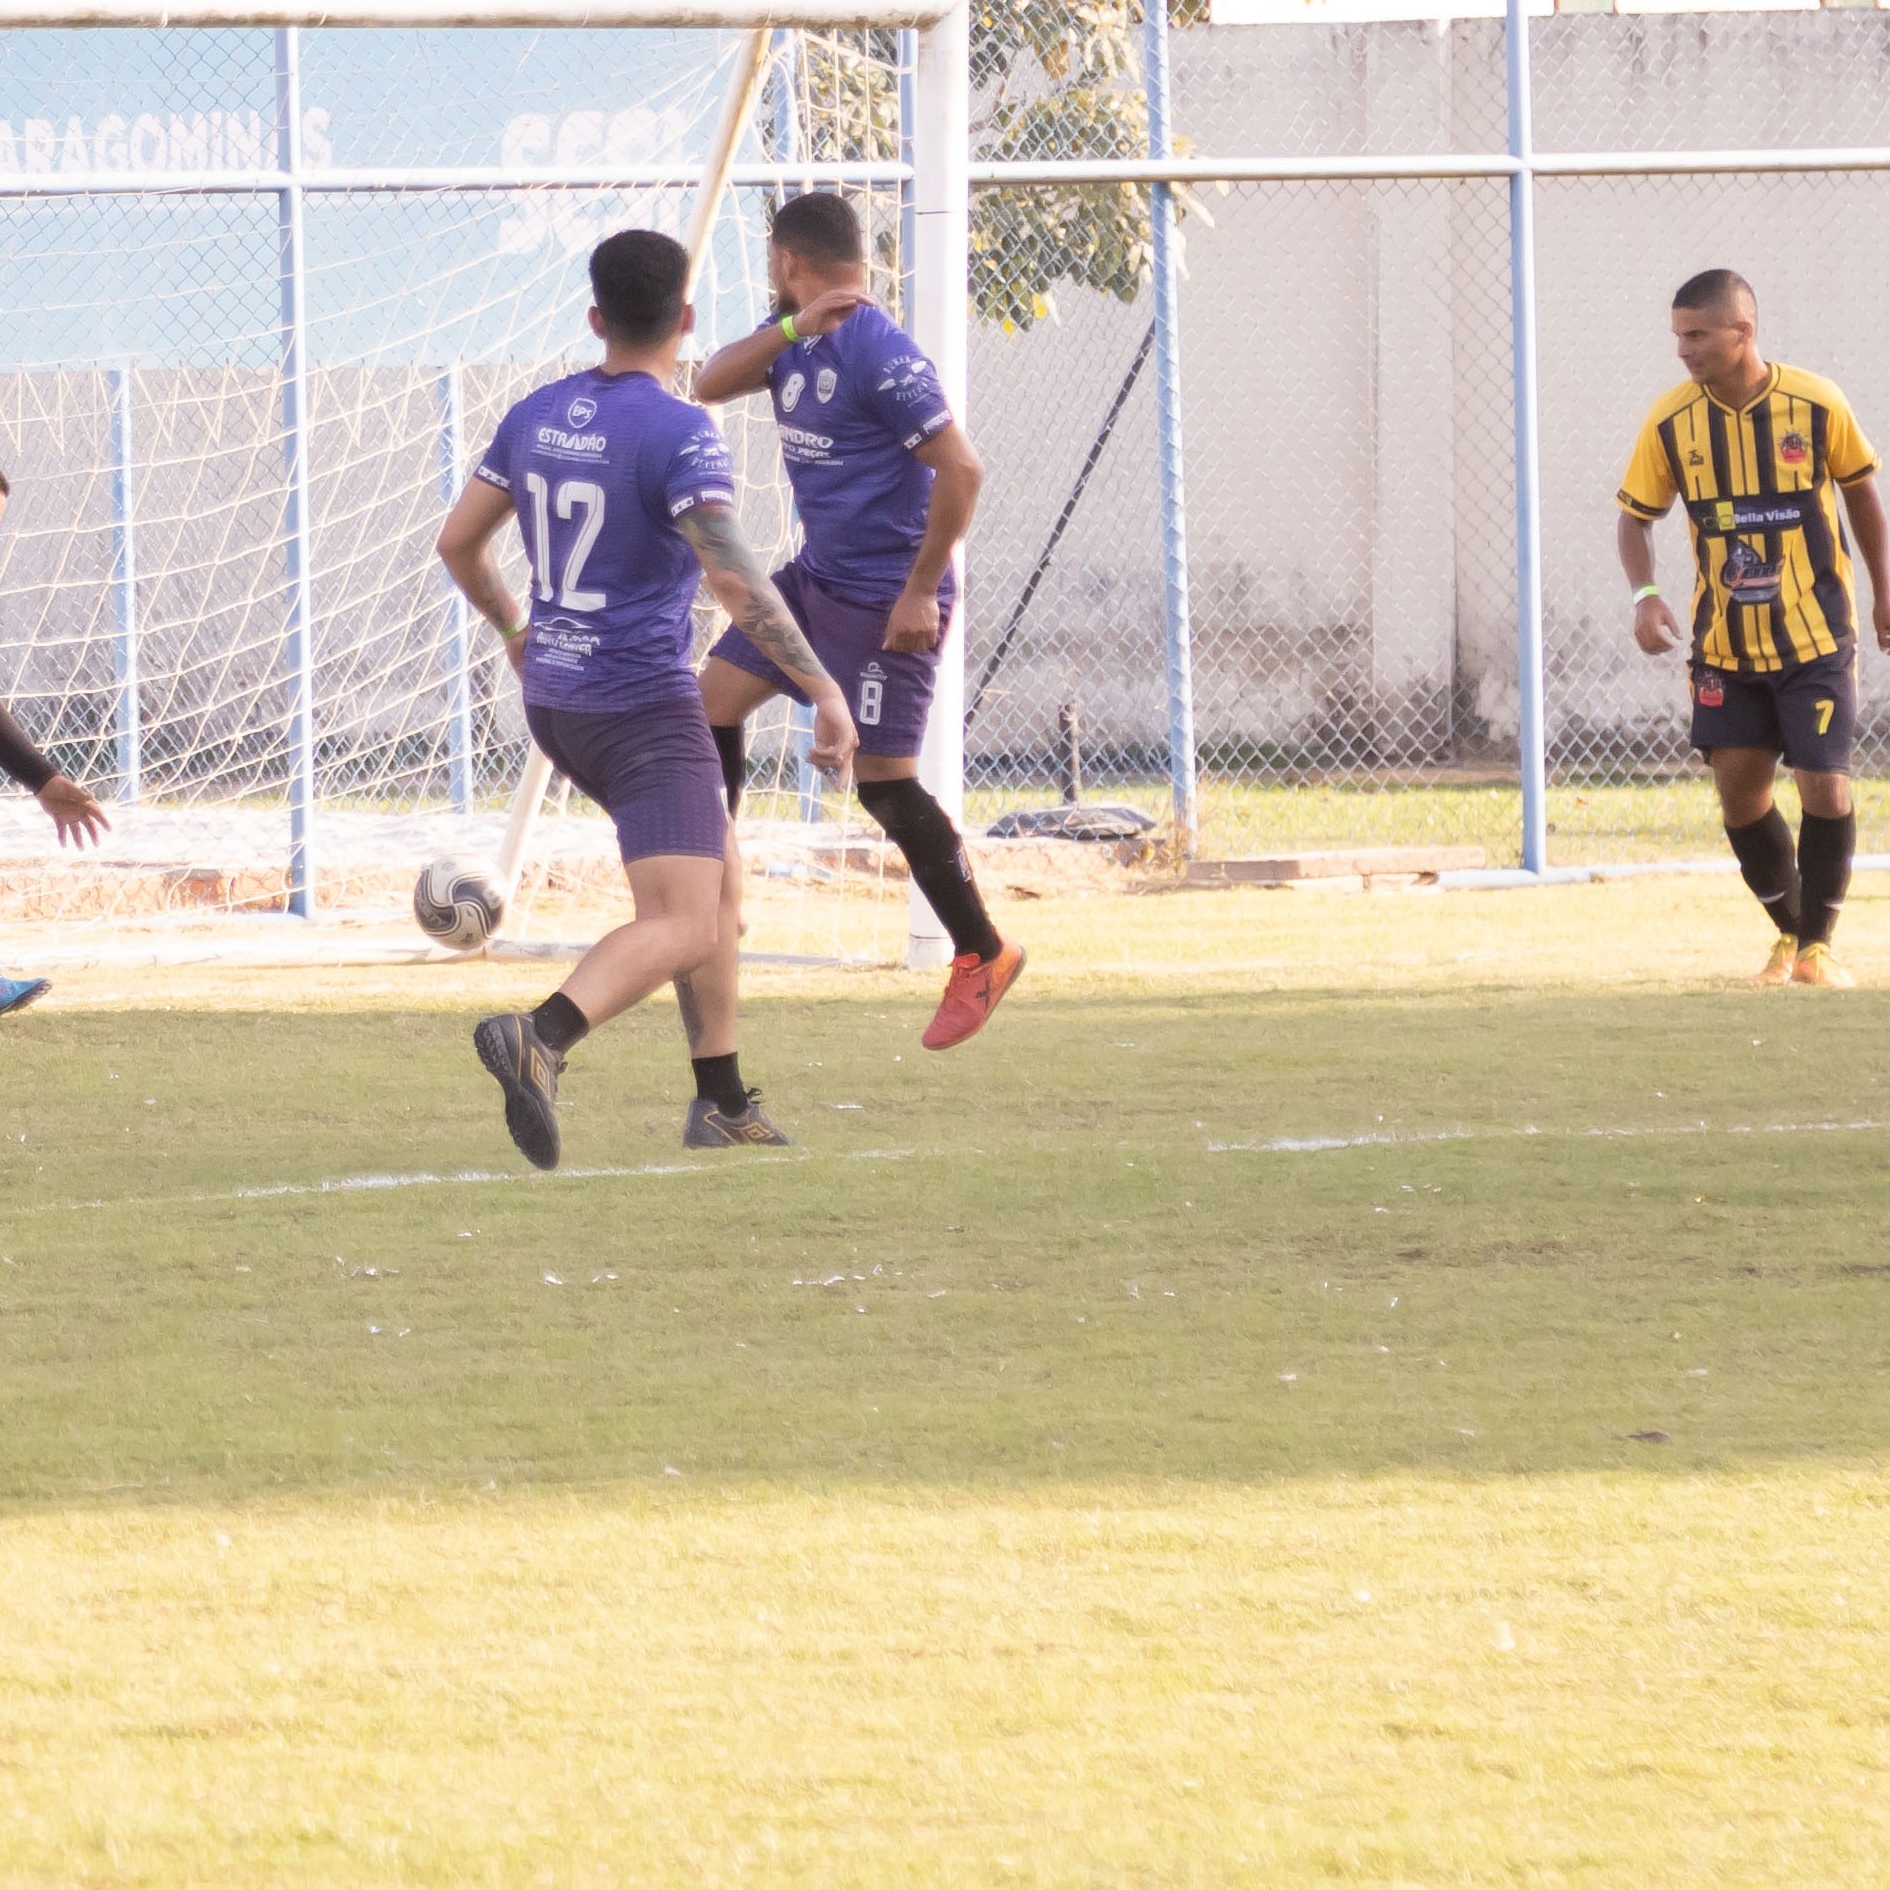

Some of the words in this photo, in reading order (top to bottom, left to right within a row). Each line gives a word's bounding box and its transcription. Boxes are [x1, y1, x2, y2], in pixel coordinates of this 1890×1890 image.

[781, 372, 807, 413] 8
[1765, 508, 1802, 523] Visão
[526, 471, 608, 612] 12
[859, 679, 884, 726] 8
[1814, 698, 1836, 736] 7
